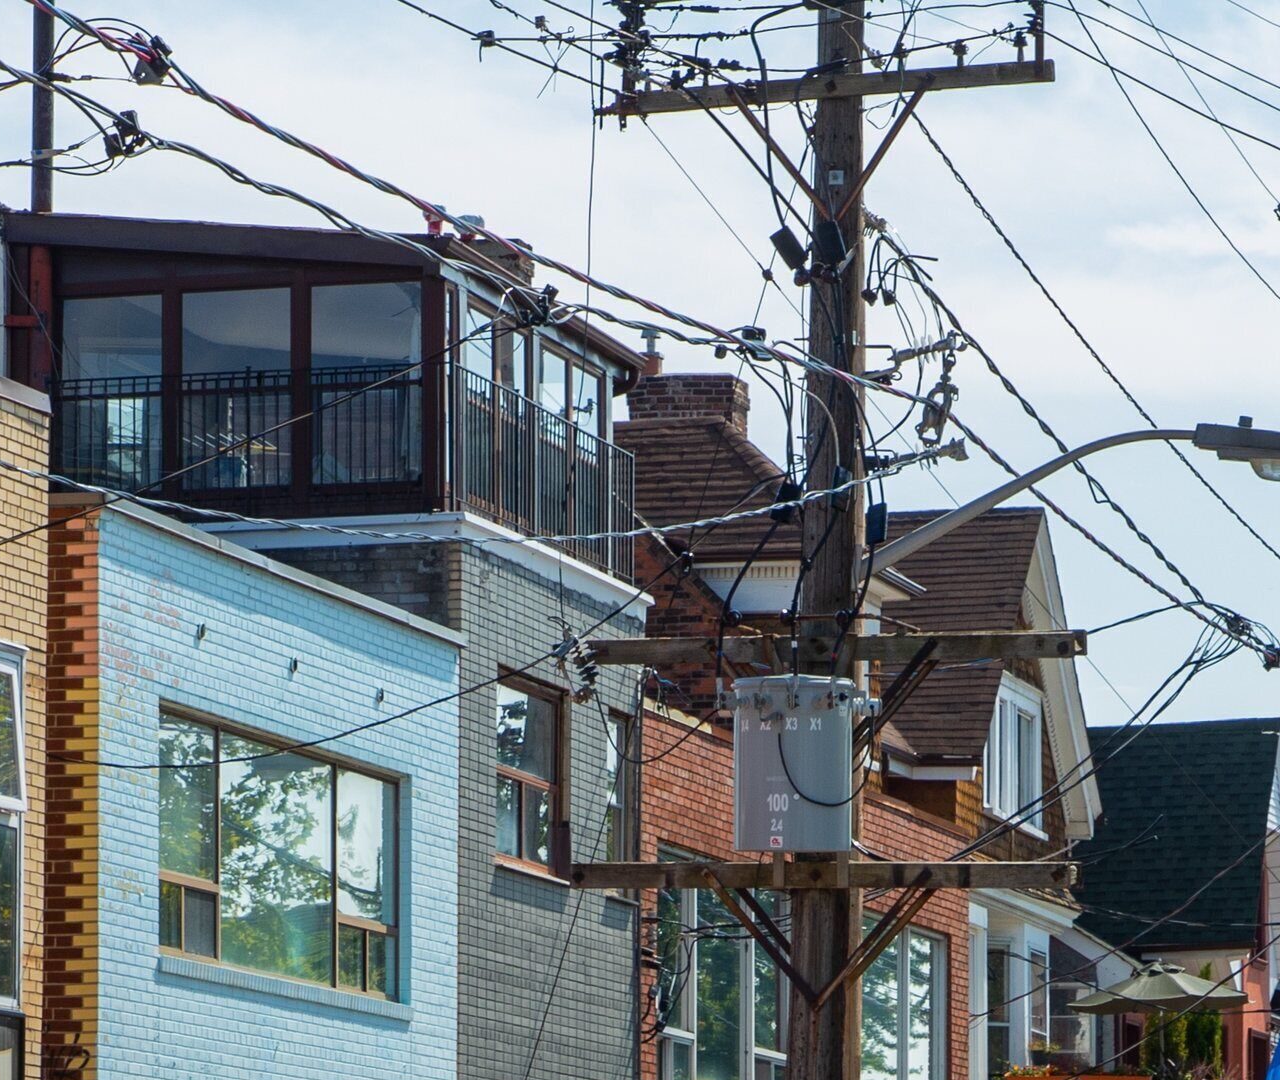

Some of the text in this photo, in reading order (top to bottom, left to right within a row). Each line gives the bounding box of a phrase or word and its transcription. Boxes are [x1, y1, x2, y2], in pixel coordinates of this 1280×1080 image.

[785, 716, 799, 731] X3
[809, 717, 822, 731] X1
[766, 793, 789, 812] 100
